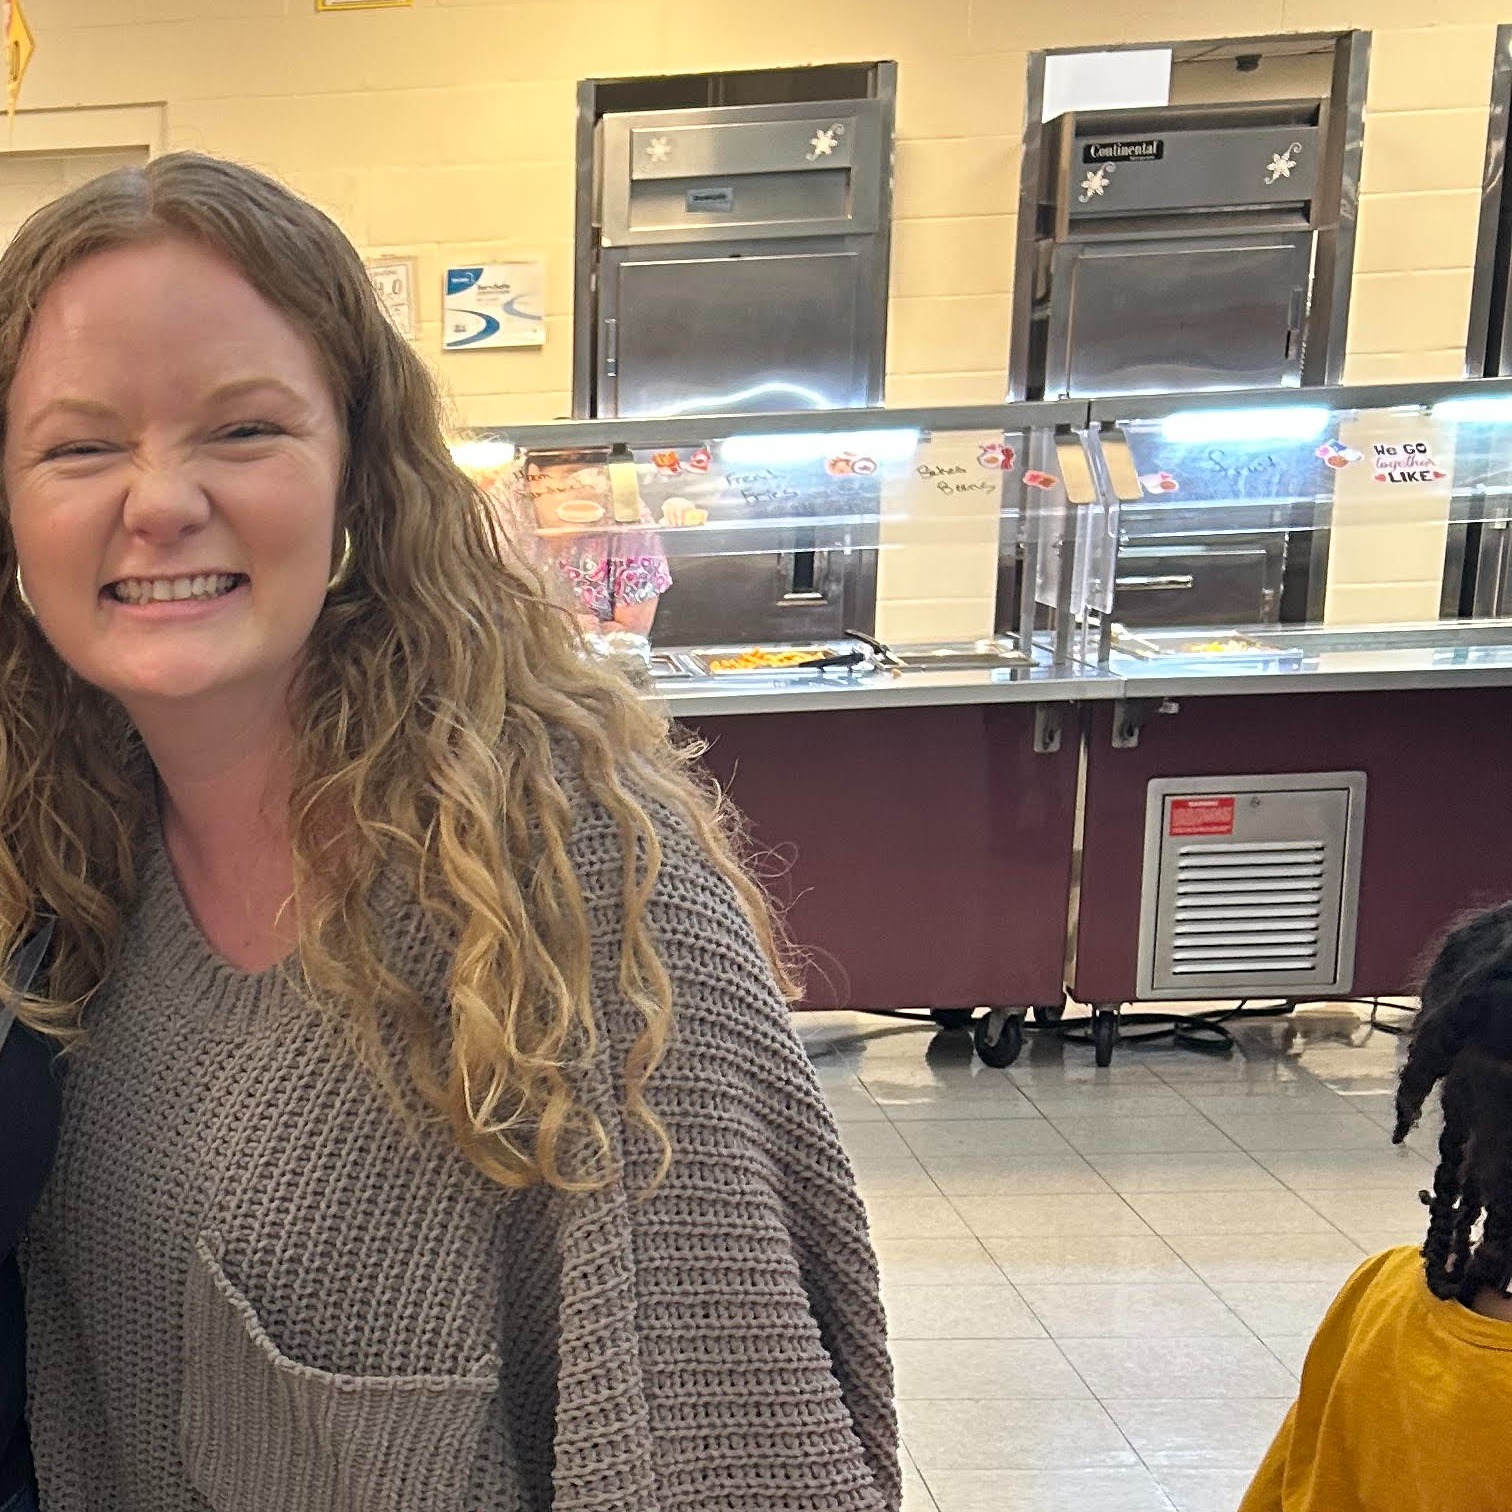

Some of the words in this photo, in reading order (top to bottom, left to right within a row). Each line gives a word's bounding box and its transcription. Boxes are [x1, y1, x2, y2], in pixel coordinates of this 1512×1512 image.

[1090, 140, 1157, 158] Continental
[1373, 444, 1397, 456] We
[1403, 442, 1427, 454] GO
[1388, 470, 1433, 483] LIKE
